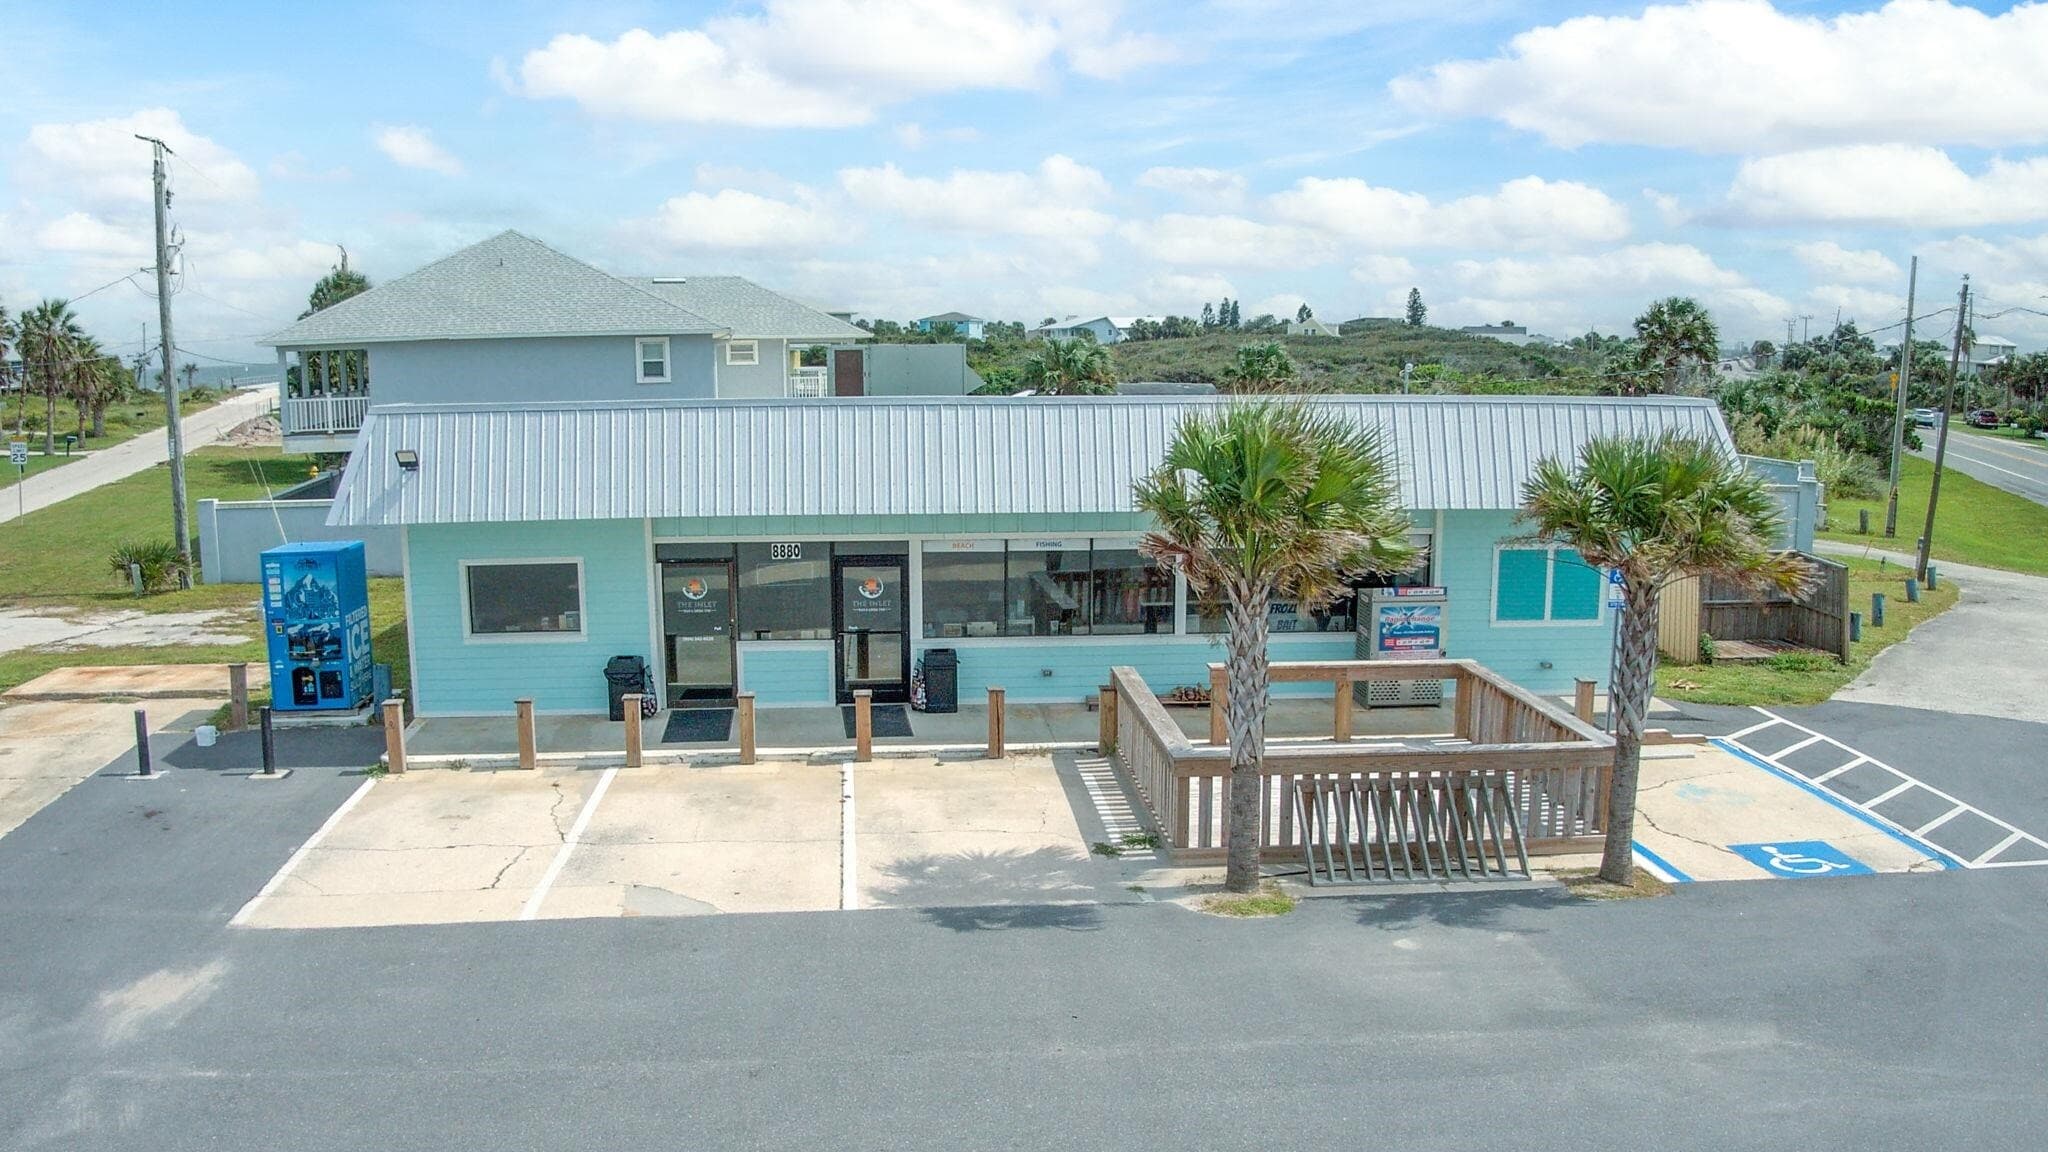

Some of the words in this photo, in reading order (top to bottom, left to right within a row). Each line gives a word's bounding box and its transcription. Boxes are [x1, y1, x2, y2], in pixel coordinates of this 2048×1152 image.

[12, 454, 26, 462] 25
[772, 544, 801, 558] 8880
[345, 605, 368, 627] FILTERED
[1277, 619, 1298, 631] BAIT
[346, 618, 370, 663] ICE
